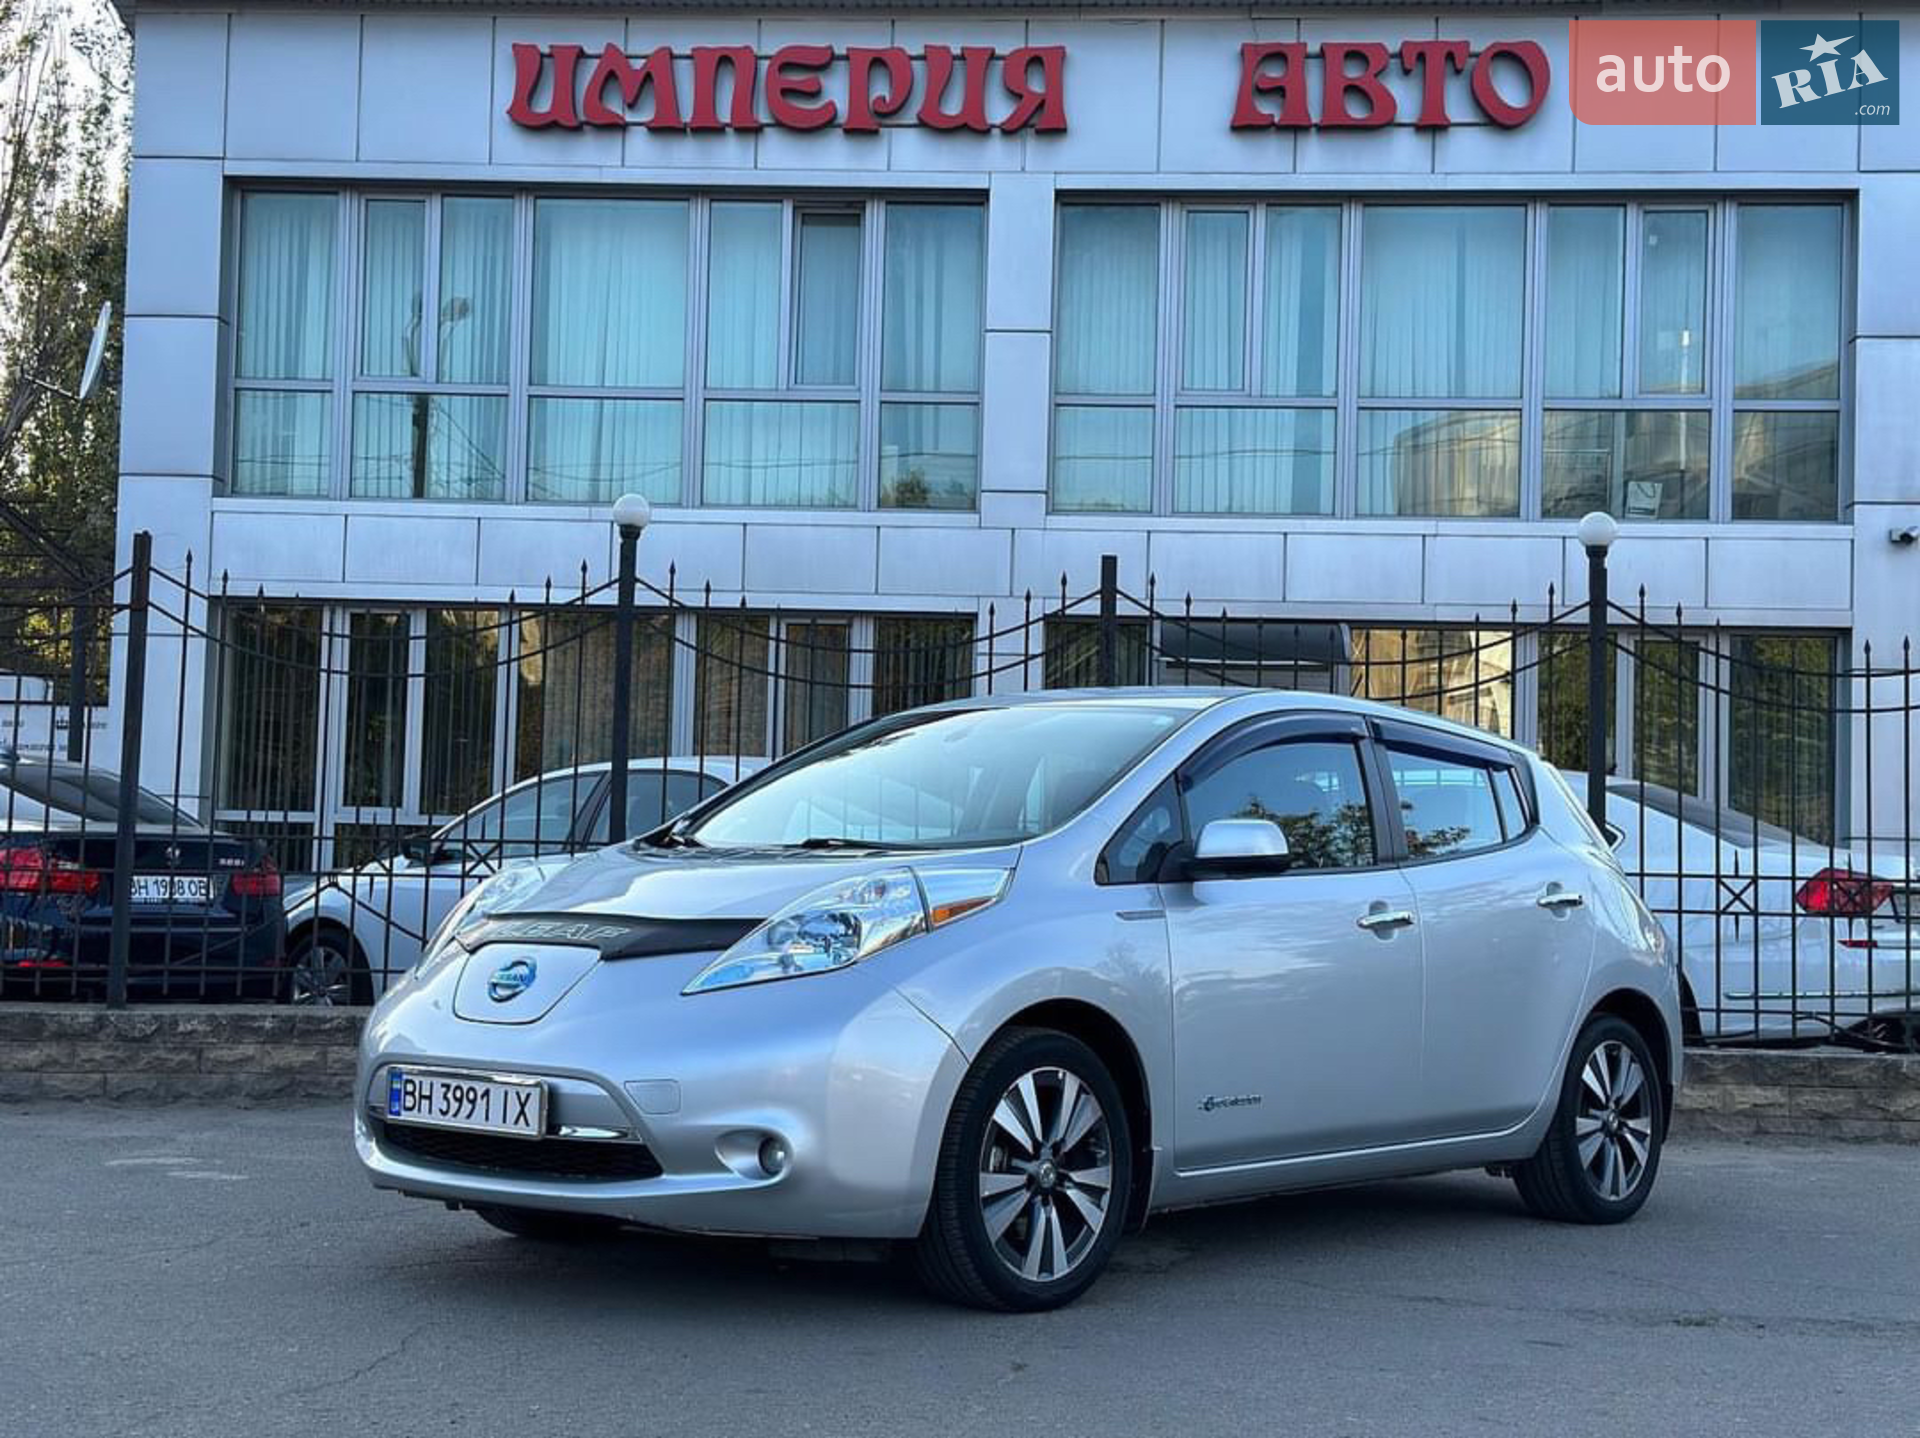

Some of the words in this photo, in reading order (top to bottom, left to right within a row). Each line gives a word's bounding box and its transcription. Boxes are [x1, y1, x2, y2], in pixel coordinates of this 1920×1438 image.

[510, 43, 1068, 132] ИМПЕРИЯ
[1230, 40, 1552, 130] АВТО
[403, 1079, 434, 1115] BH
[438, 1083, 490, 1122] 3991
[503, 1090, 532, 1127] IX
